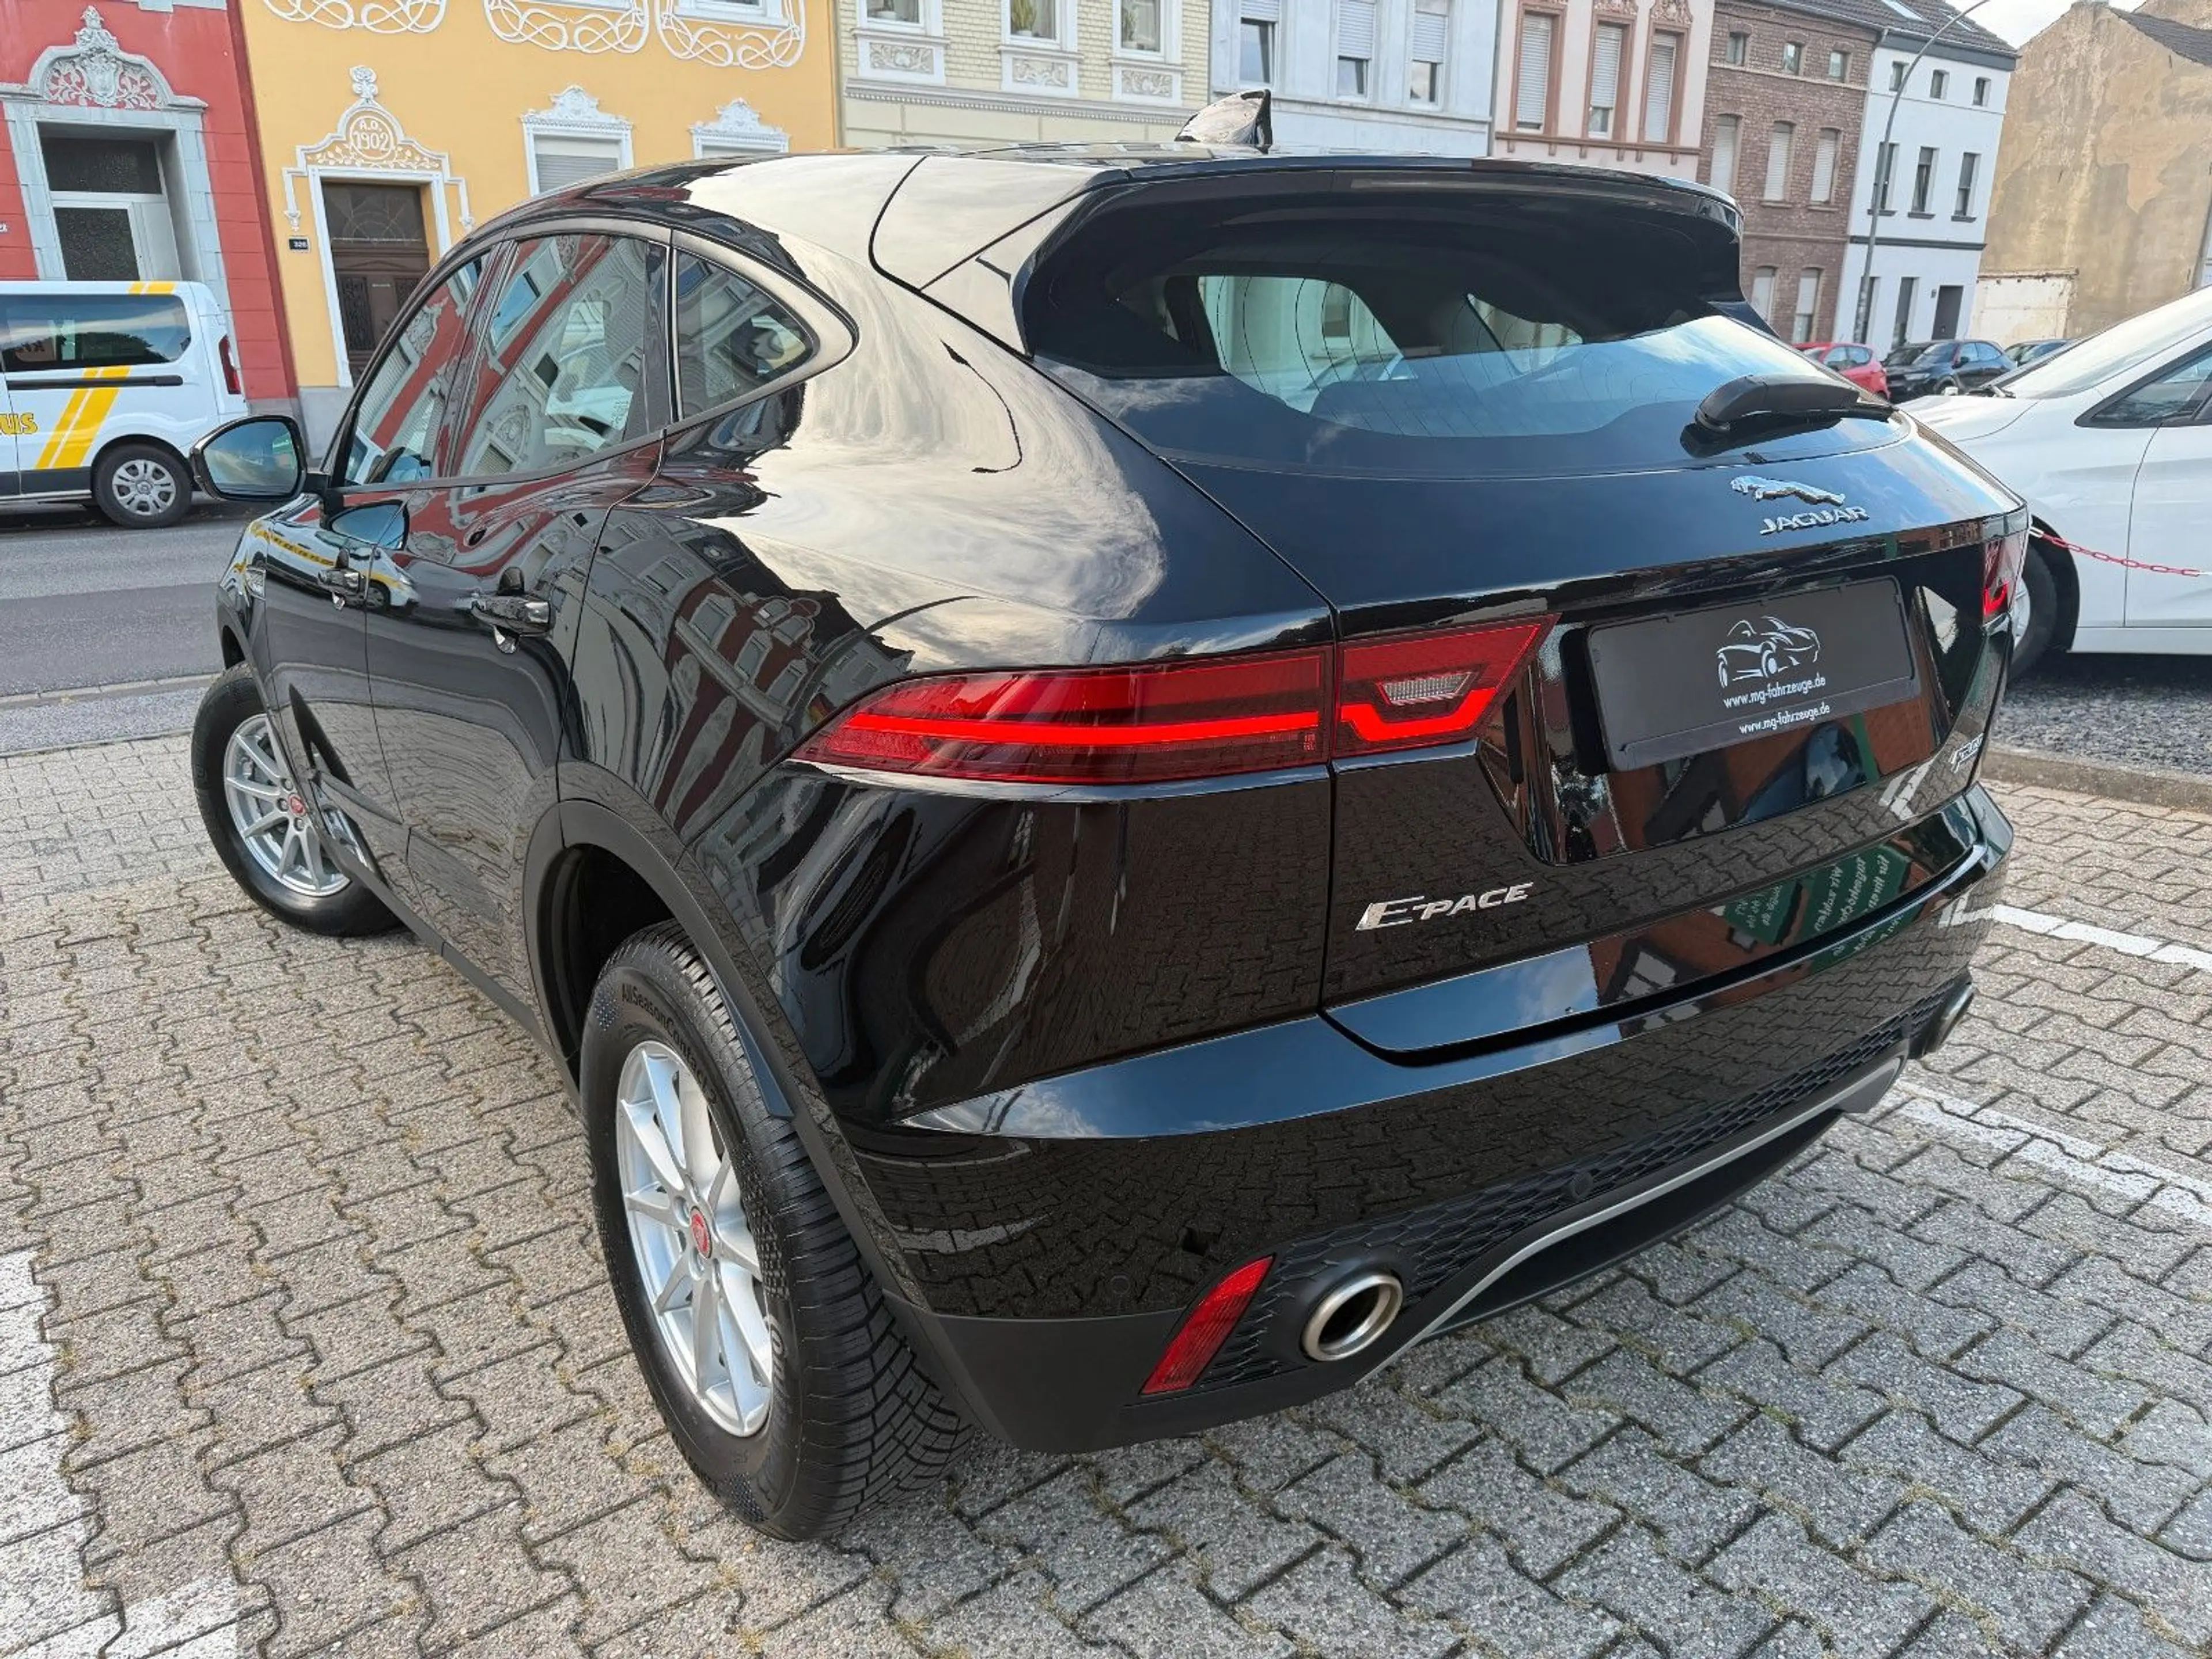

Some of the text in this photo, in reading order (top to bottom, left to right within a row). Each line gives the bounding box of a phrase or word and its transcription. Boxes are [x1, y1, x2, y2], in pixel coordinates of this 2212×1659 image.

[353, 131, 389, 151] 1902
[1759, 506, 1870, 535] JAGUAR
[1723, 672, 1826, 709] www.mg-fahrzeuge.de
[1738, 701, 1831, 734] www.mg-fahrzeuge.de
